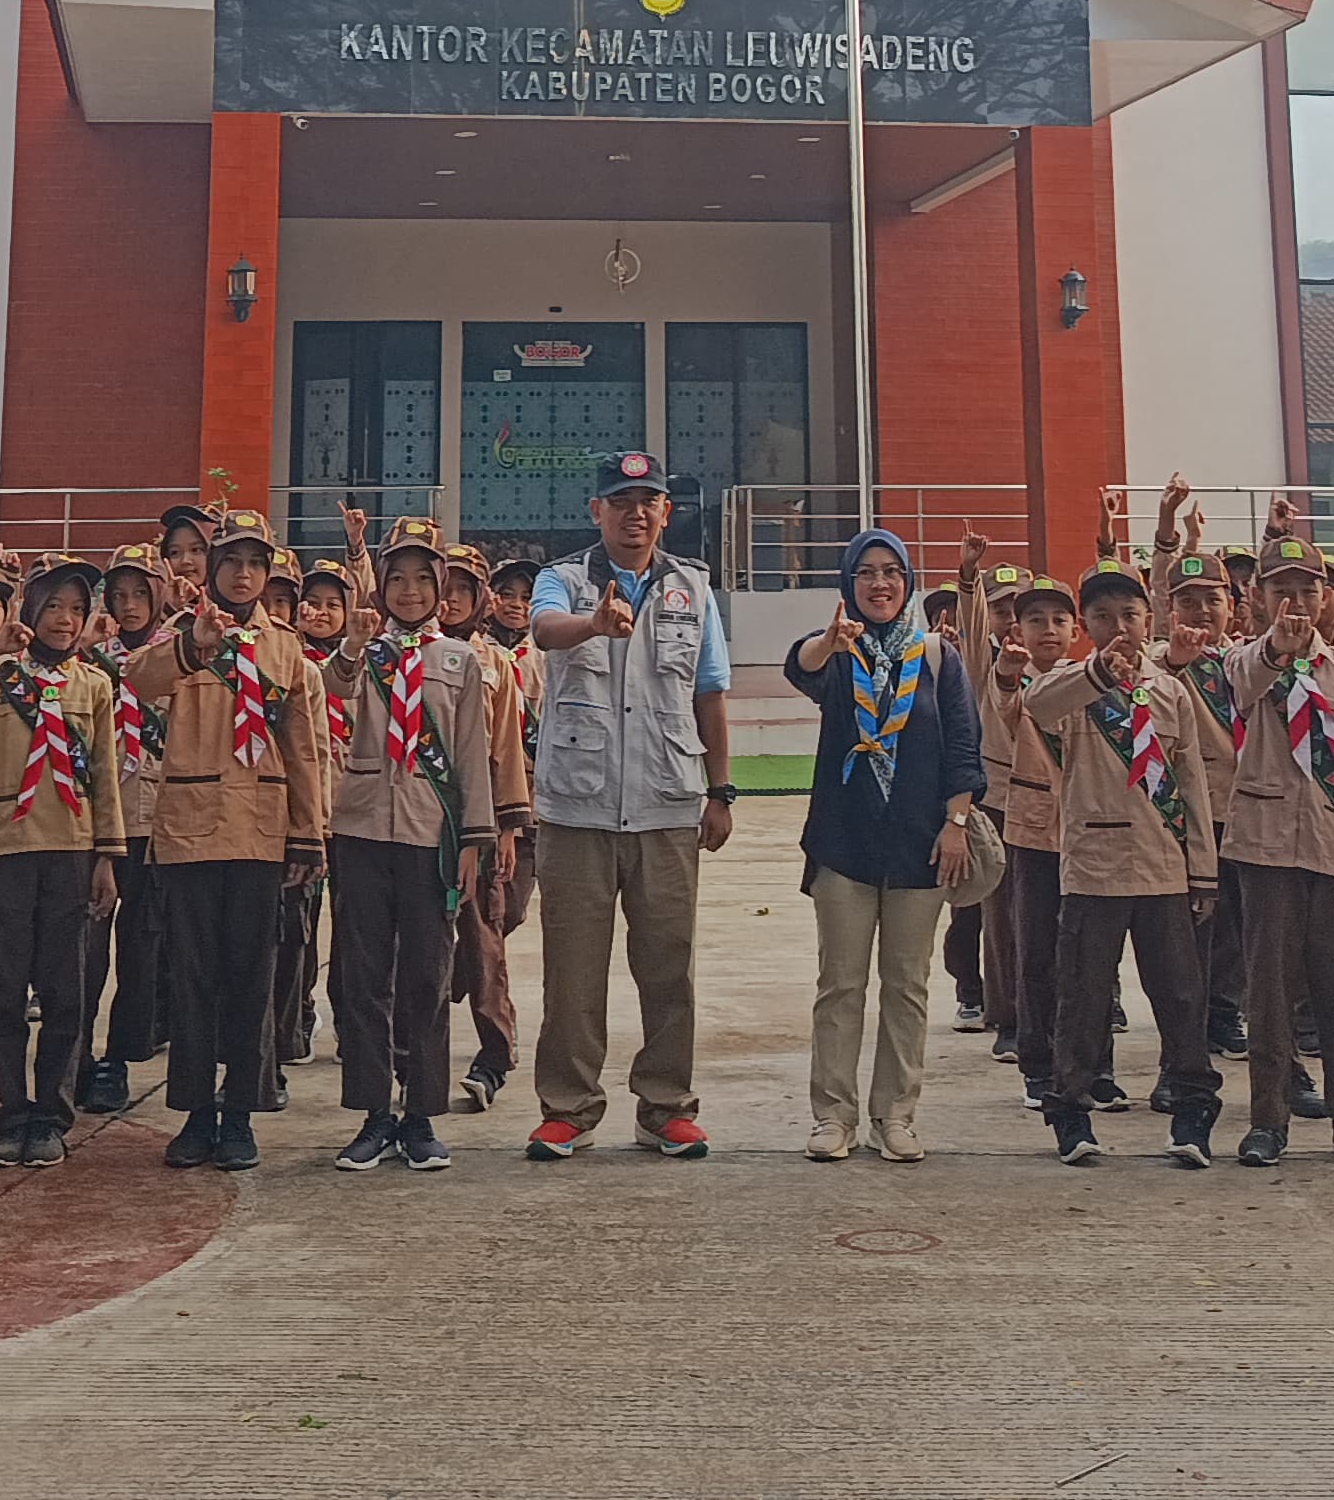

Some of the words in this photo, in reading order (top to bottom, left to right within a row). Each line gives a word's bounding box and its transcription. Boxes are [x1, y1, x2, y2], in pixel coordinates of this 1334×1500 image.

[340, 23, 488, 64] KANTOR
[500, 26, 714, 67] KECAMATAN
[725, 29, 976, 73] LEUWISADENG
[500, 70, 697, 104] KABUPATEN
[708, 72, 826, 105] BOGOR
